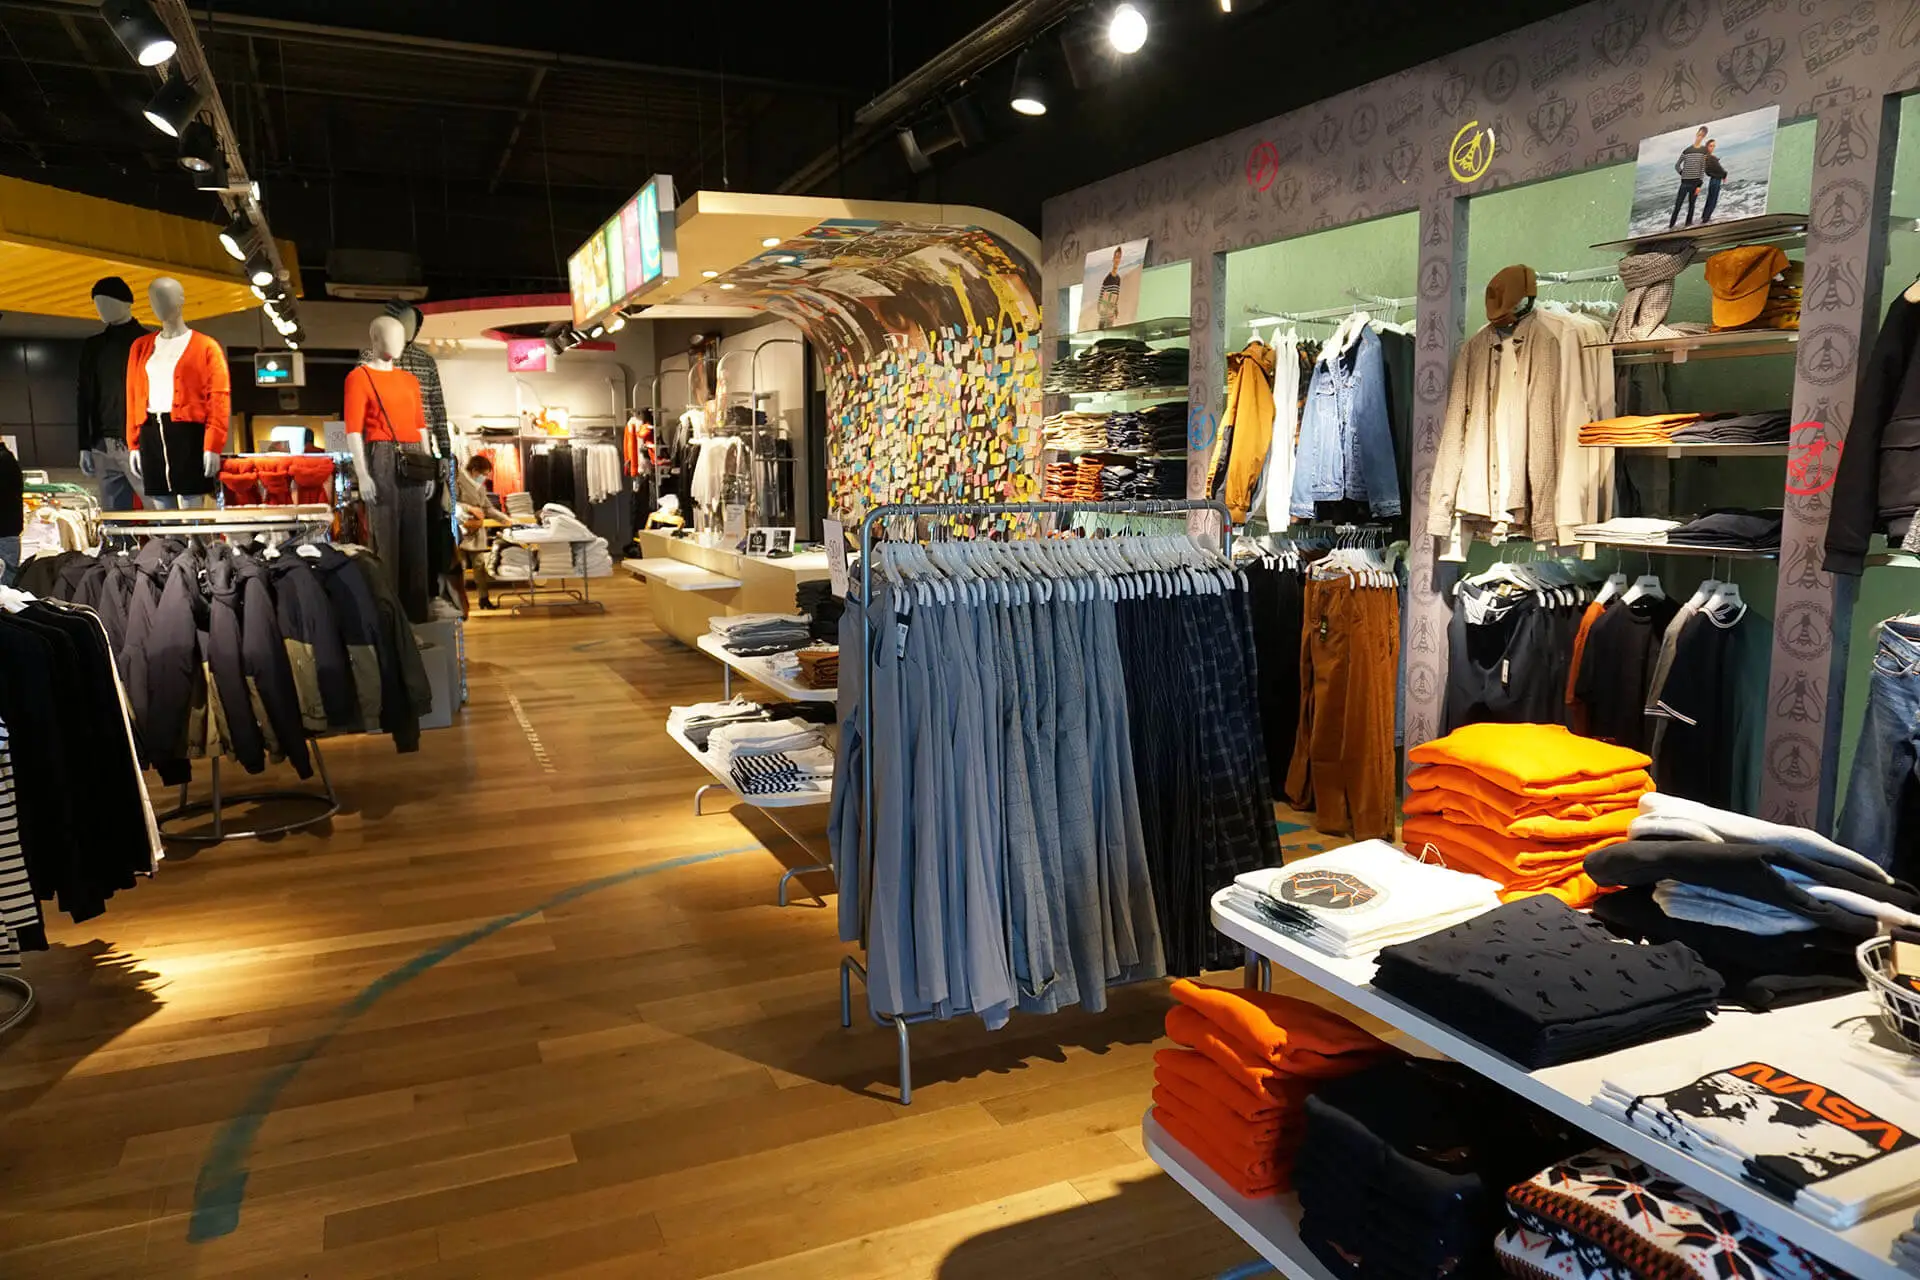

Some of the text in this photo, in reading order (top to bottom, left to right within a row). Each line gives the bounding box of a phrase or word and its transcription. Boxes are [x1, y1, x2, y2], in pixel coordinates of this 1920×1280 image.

[1798, 0, 1877, 59] Bee
[1805, 24, 1880, 76] Bizzbee
[1586, 71, 1642, 118] Bee
[1591, 92, 1645, 132] Bizzbee
[1728, 1062, 1903, 1151] NASA
